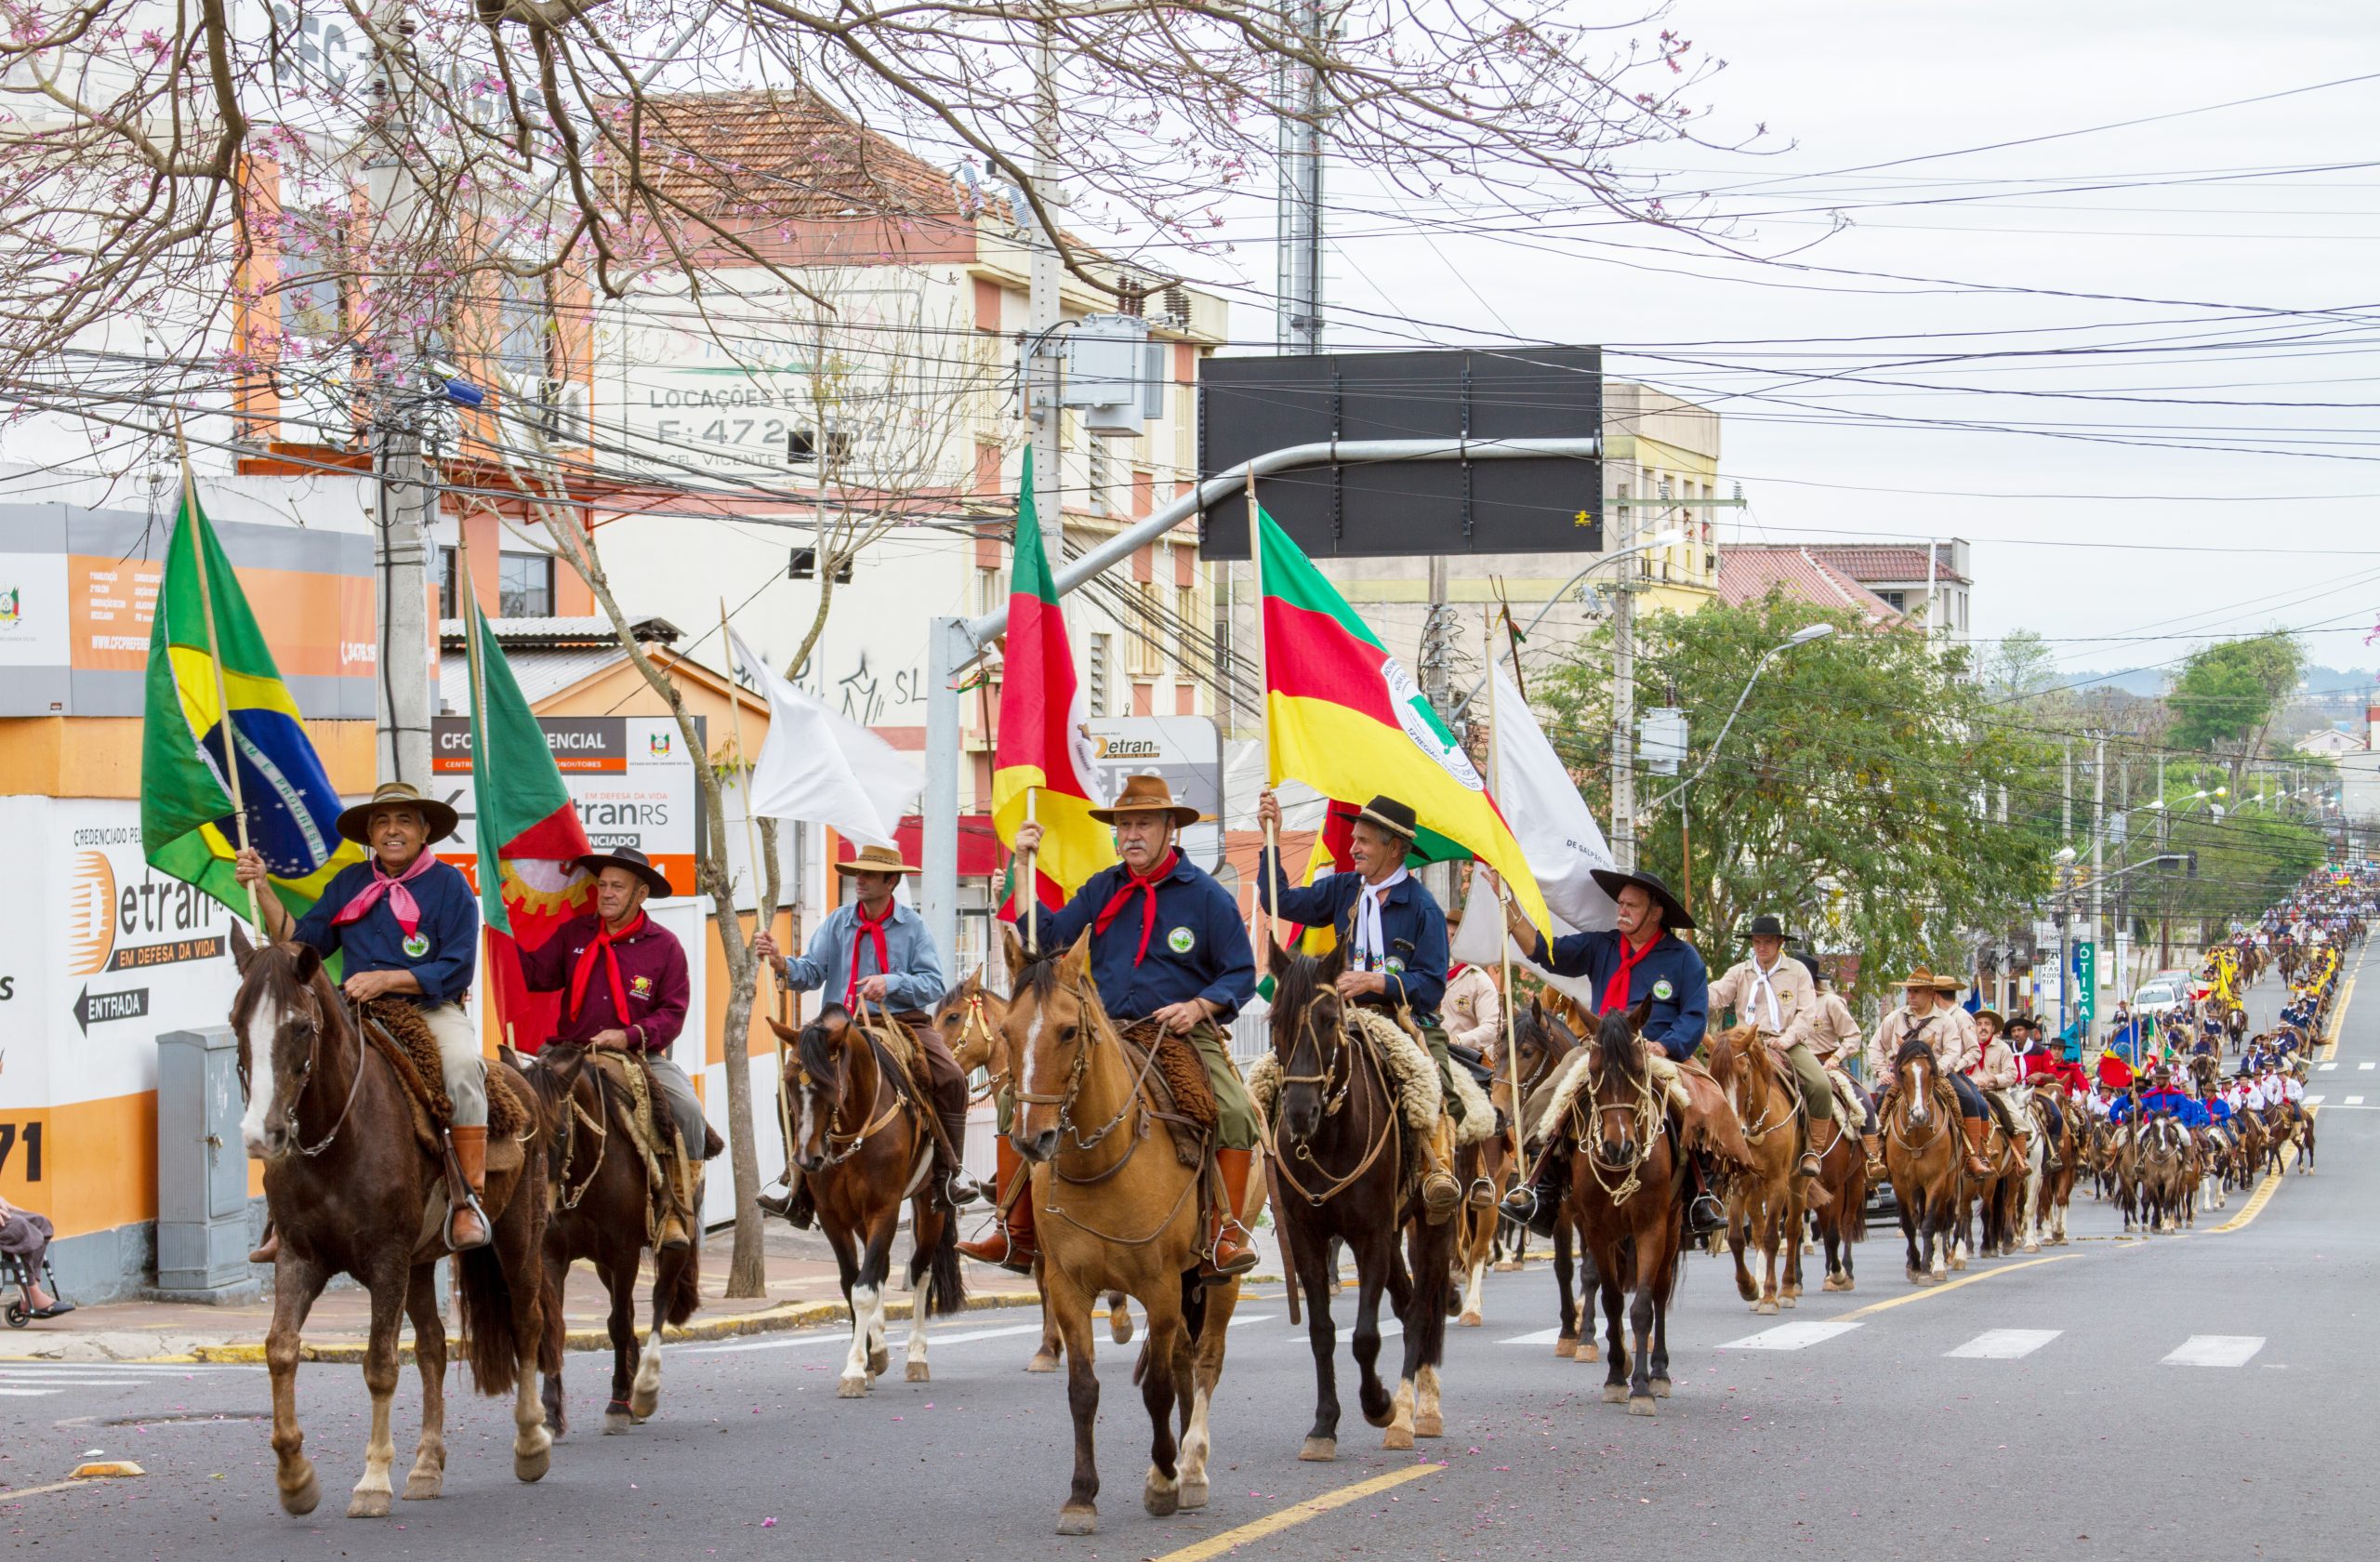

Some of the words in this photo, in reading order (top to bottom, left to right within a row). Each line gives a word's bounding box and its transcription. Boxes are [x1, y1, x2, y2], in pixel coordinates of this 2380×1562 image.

[651, 383, 774, 413] LOCAÇÕES
[784, 388, 797, 406] E
[800, 386, 900, 407] VNDAS
[702, 454, 777, 466] VICENTE
[441, 733, 472, 749] CFC
[548, 733, 606, 748] ENCIAL
[275, 777, 325, 862] PROGRESSO
[74, 827, 127, 847] CREDENCIADO
[130, 827, 142, 843] PEL
[588, 836, 638, 847] NCIADO
[1567, 839, 1578, 849] DE
[1579, 844, 1603, 863] GALPÃO
[68, 850, 209, 976] Detran
[119, 948, 134, 967] EM
[138, 944, 174, 965] DEFESA
[178, 942, 192, 960] DA
[194, 939, 216, 959] VIDA
[2079, 946, 2091, 1017] ÓTICA
[88, 993, 140, 1020] ENTRADA
